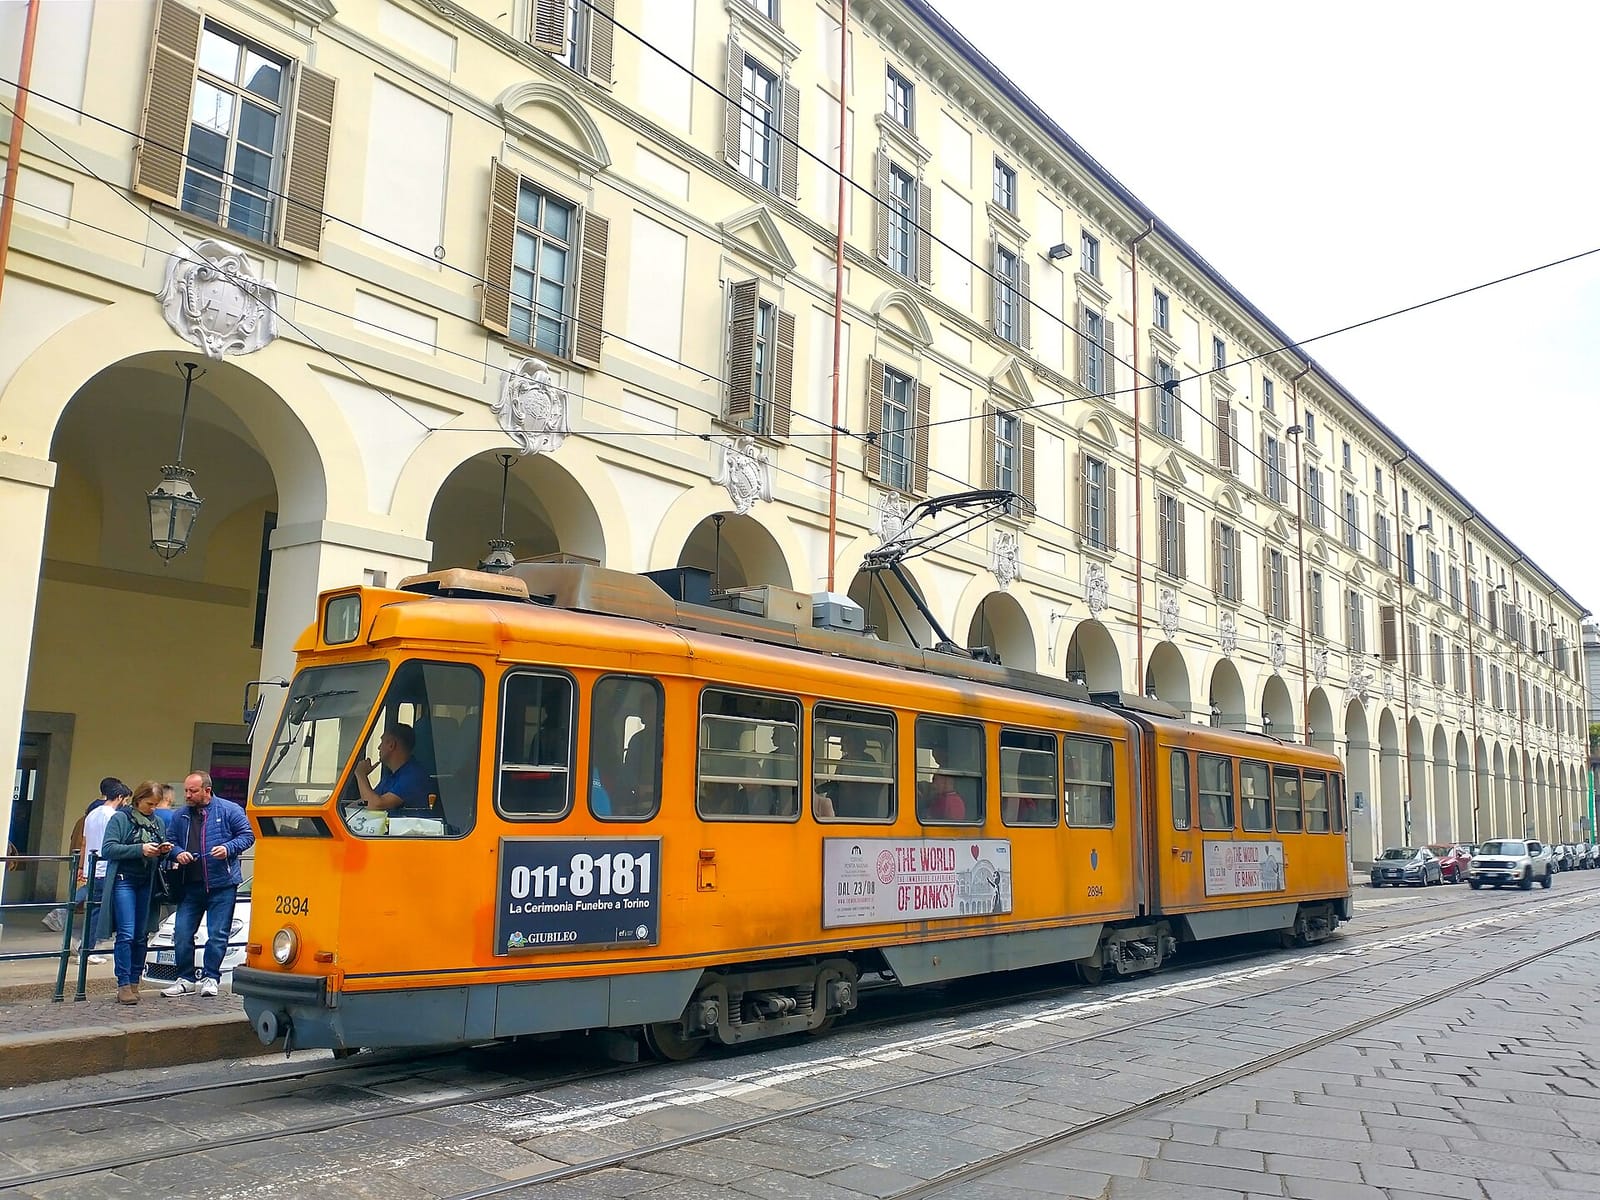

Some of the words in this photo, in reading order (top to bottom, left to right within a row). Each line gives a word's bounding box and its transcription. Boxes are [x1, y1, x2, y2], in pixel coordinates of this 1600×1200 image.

[895, 847, 917, 872] THE
[919, 846, 955, 872] WORLD
[1233, 846, 1242, 862] THE
[1243, 846, 1258, 862] WORLD
[510, 852, 651, 899] 011-8181
[838, 881, 850, 896] DAL
[1088, 885, 1103, 897] 2894
[275, 895, 309, 916] 2894
[897, 886, 911, 911] OF
[914, 884, 955, 910] BANKSY
[509, 903, 522, 914] La
[524, 901, 574, 913] Cerimonia
[575, 899, 613, 911] Funebre
[614, 901, 621, 909] a
[622, 898, 650, 909] Torino
[528, 931, 577, 944] GIUBILEO
